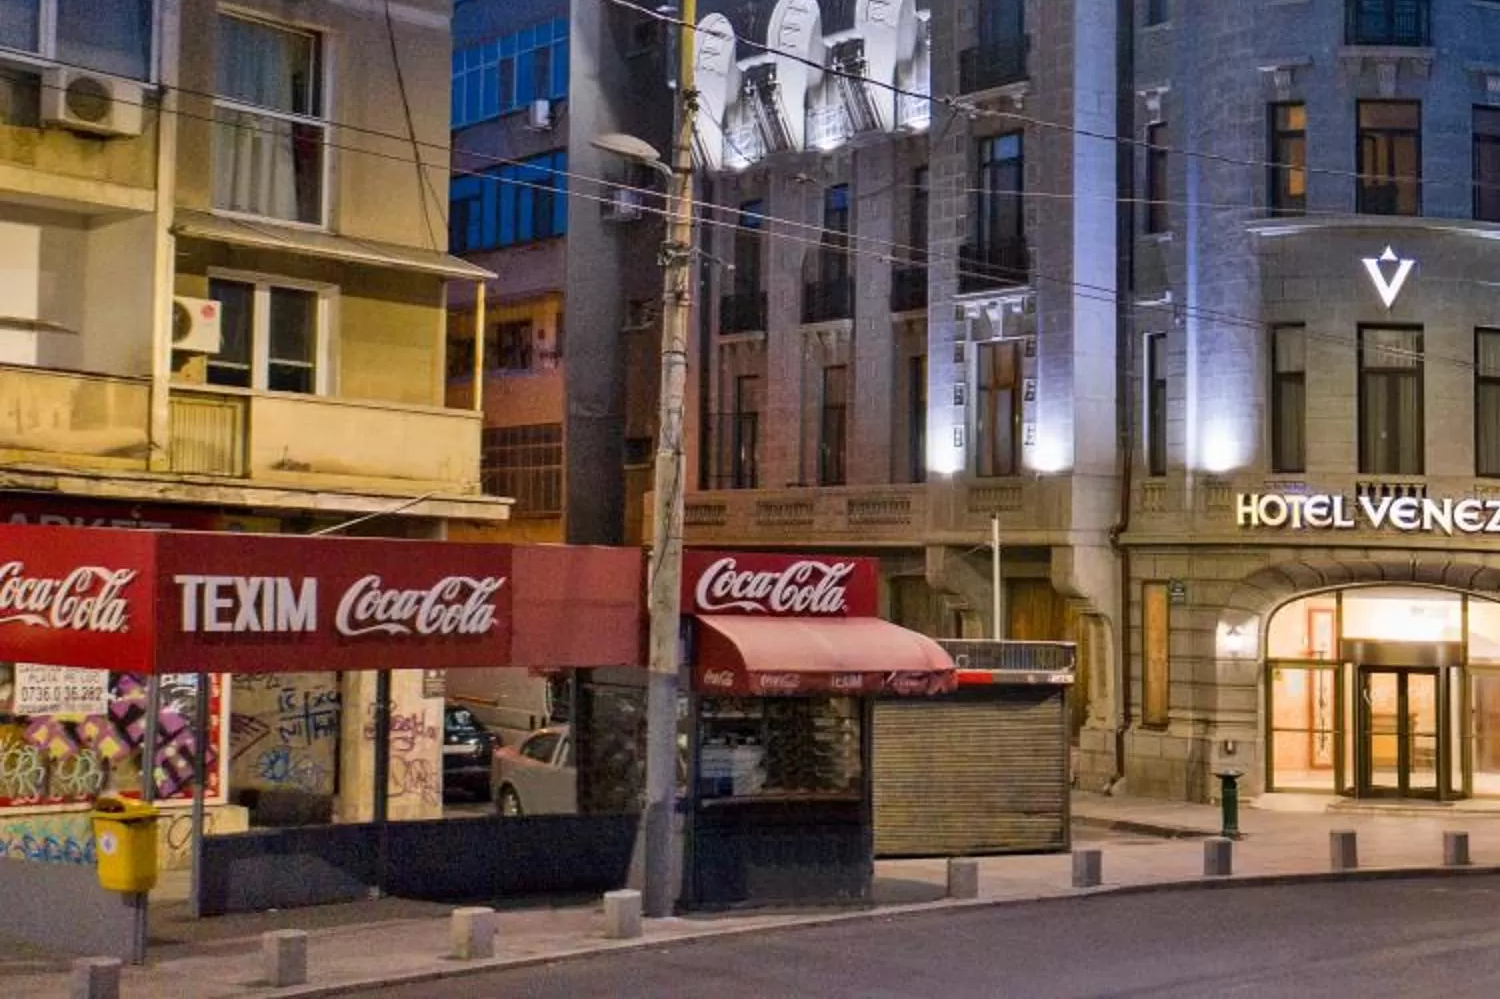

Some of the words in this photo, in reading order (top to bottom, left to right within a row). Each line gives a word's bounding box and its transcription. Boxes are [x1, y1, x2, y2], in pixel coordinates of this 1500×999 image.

[1236, 493, 1355, 528] HOTEL
[174, 574, 318, 632] TEXIM
[335, 574, 506, 636] Coca-Cola
[695, 557, 856, 613] Coca-Cola
